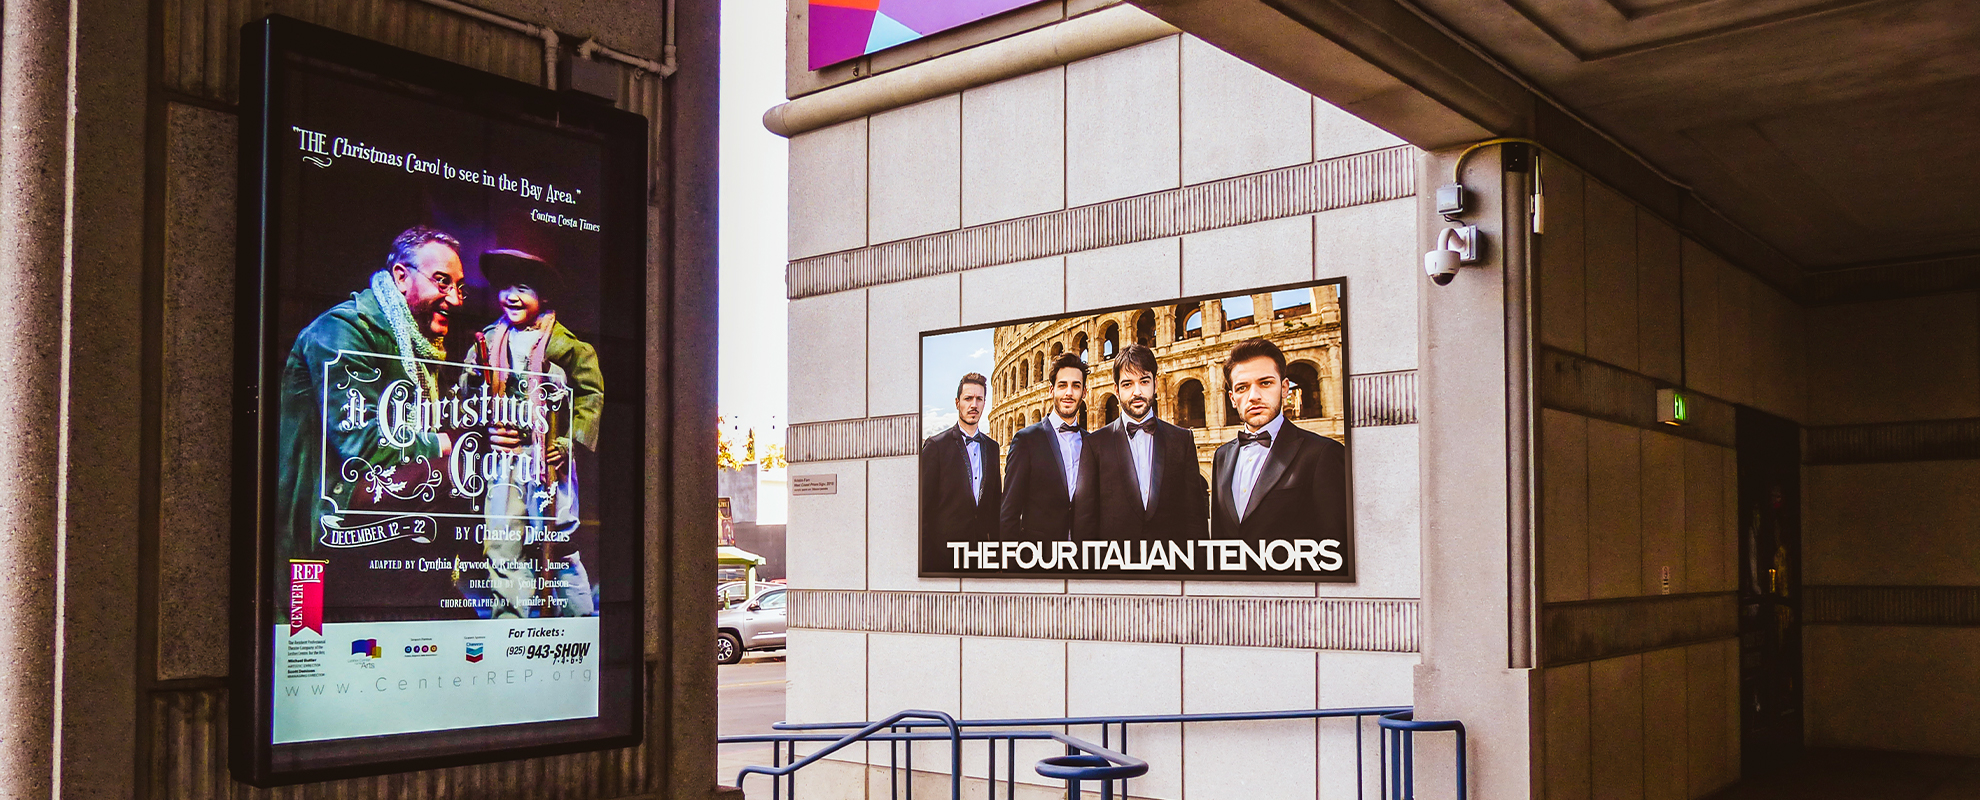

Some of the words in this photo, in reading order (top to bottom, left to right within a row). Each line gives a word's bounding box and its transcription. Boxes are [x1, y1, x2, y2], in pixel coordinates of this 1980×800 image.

[332, 137, 403, 167] Christmas
[406, 153, 440, 175] Carol
[443, 162, 456, 180] to
[458, 168, 480, 184] see
[482, 170, 495, 187] in
[498, 173, 518, 192] the
[520, 178, 543, 201] Bay
[558, 214, 578, 228] Costa
[579, 218, 600, 232] Times
[377, 379, 551, 464] Christmas
[449, 431, 542, 511] Carol
[331, 525, 387, 545] DECEMBER
[388, 521, 400, 537] 12
[413, 519, 426, 534] 22
[455, 526, 471, 541] BY
[475, 523, 522, 544] Charles
[523, 525, 570, 545] Dickens
[369, 559, 402, 570] ADAPTED
[405, 559, 415, 570] BY
[418, 557, 452, 572] Cynthia
[545, 558, 570, 571] James
[947, 541, 1000, 570] THE
[1001, 540, 1078, 570] FOUR
[1081, 539, 1195, 571] ITALIAN
[1198, 538, 1344, 572] TENORS
[292, 563, 324, 580] REP
[538, 577, 570, 591] Denison
[291, 583, 304, 628] CENTER
[547, 595, 569, 609] Perry
[508, 628, 525, 638] For
[506, 645, 526, 657] (925)
[526, 642, 591, 659] 943-SHOW
